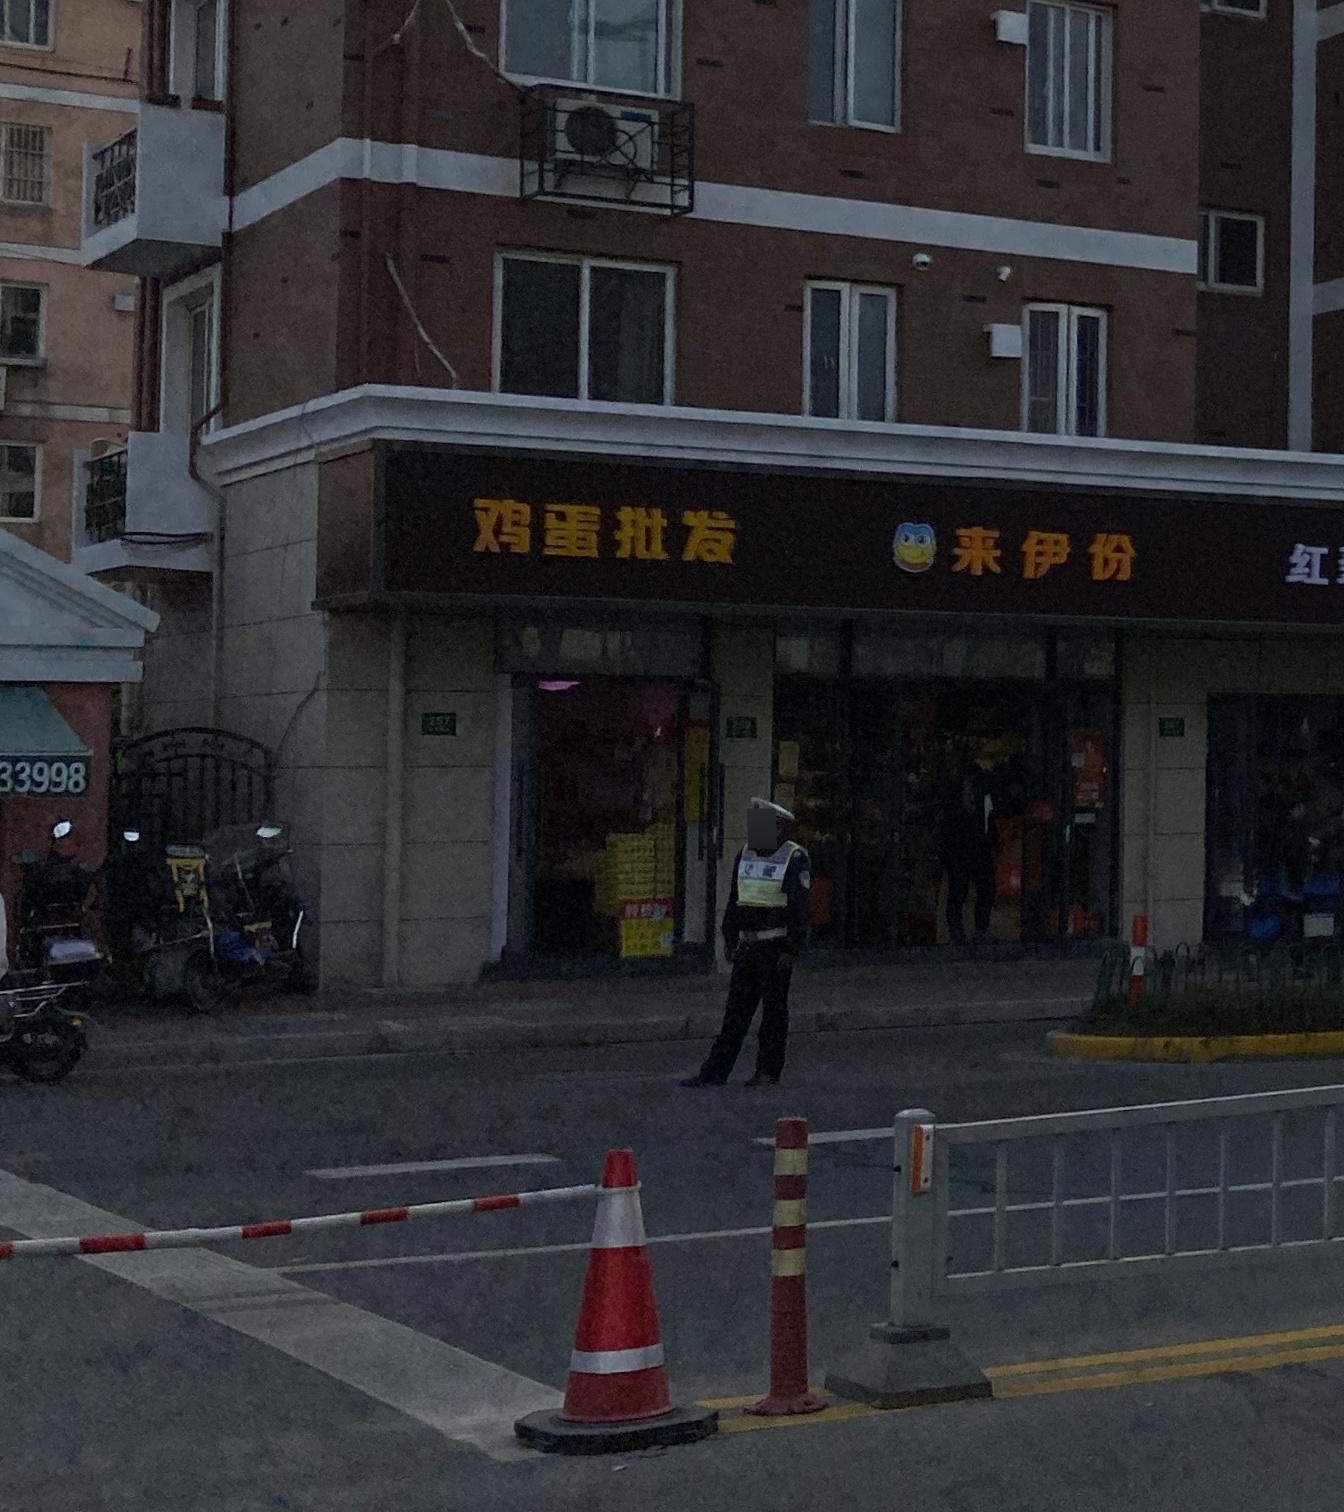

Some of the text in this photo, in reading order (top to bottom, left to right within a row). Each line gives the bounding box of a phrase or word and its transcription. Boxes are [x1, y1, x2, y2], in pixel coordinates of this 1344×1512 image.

[473, 497, 739, 566] 鸡蛋批发
[953, 524, 1138, 583] 来伊份
[0, 761, 87, 794] 33998
